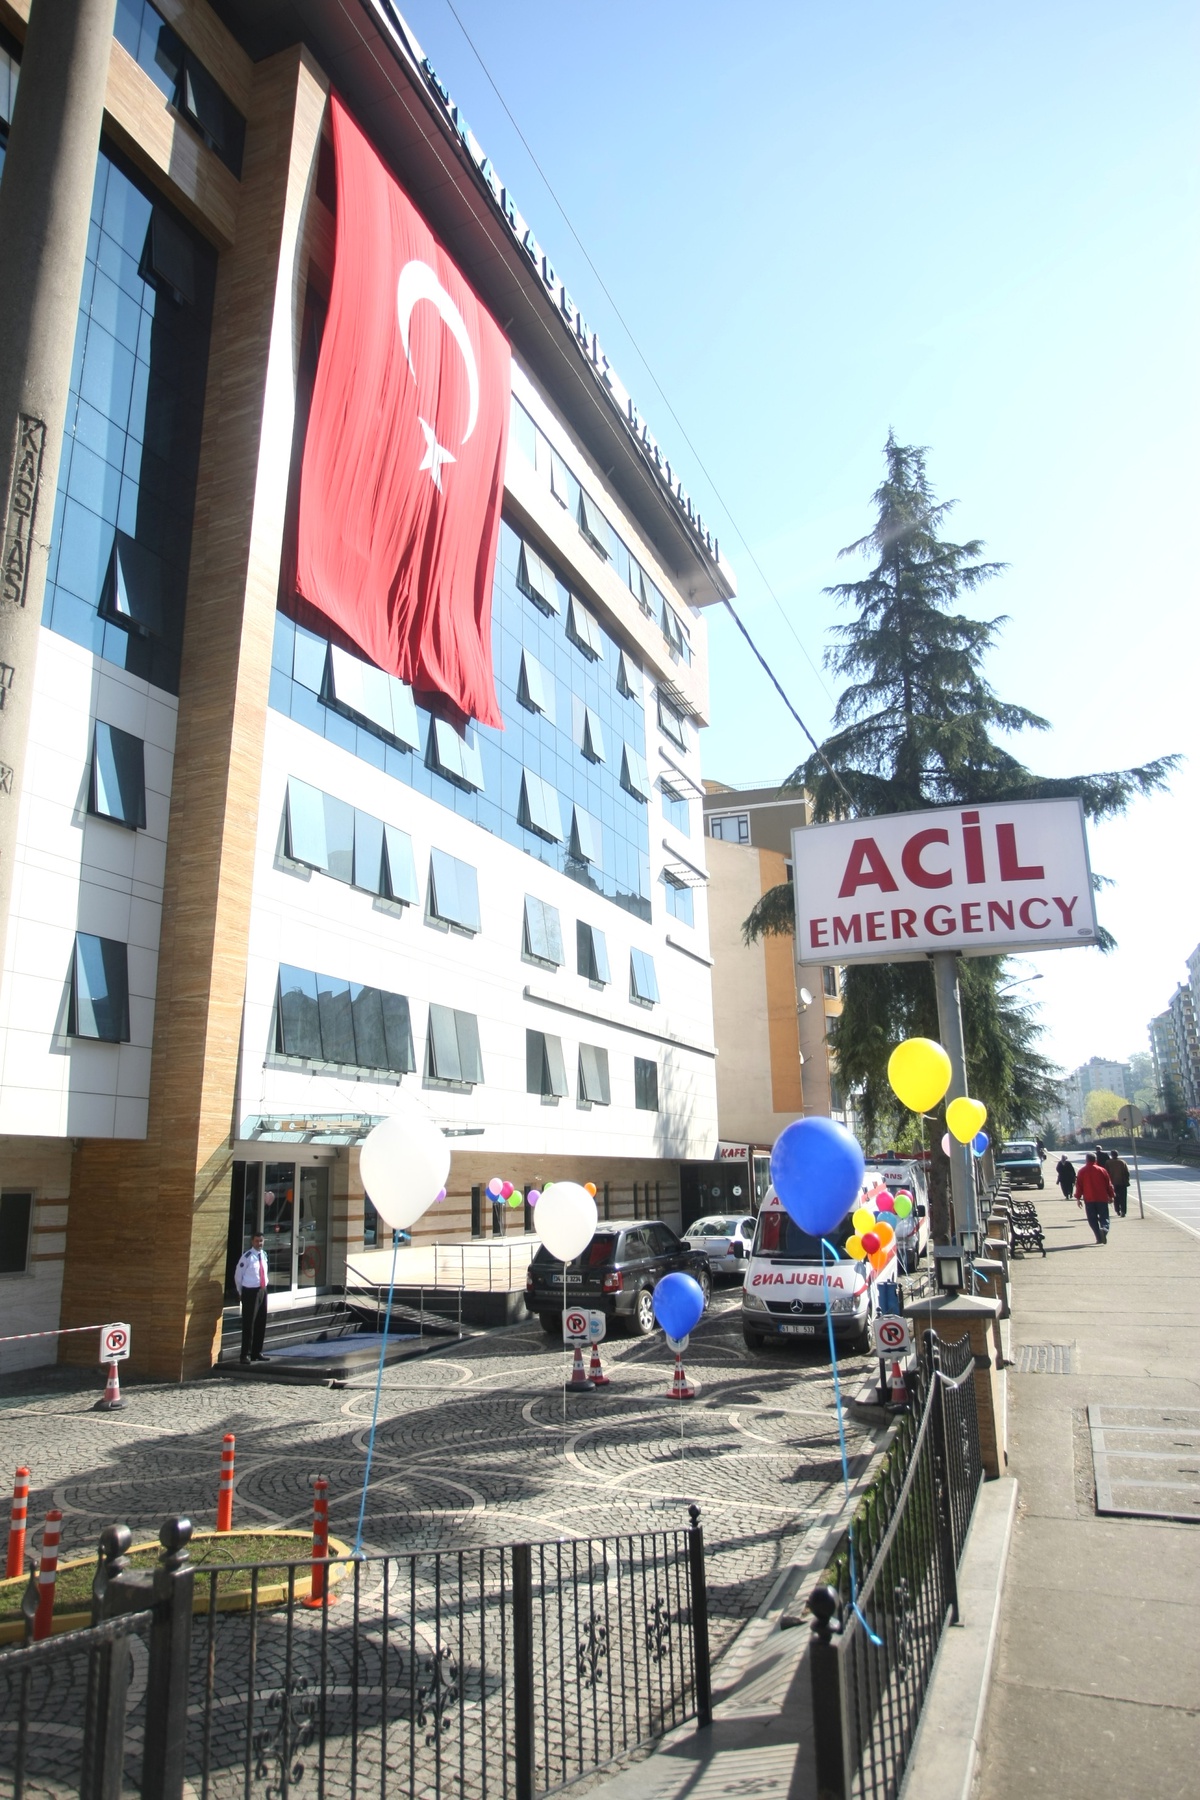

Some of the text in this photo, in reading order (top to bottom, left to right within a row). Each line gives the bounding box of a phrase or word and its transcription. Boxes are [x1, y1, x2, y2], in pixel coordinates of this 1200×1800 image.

[451, 106, 618, 389] KARADENİZ
[838, 811, 1045, 898] ACİL
[809, 895, 1079, 948] EMERGENCY
[721, 1148, 747, 1158] KAFE
